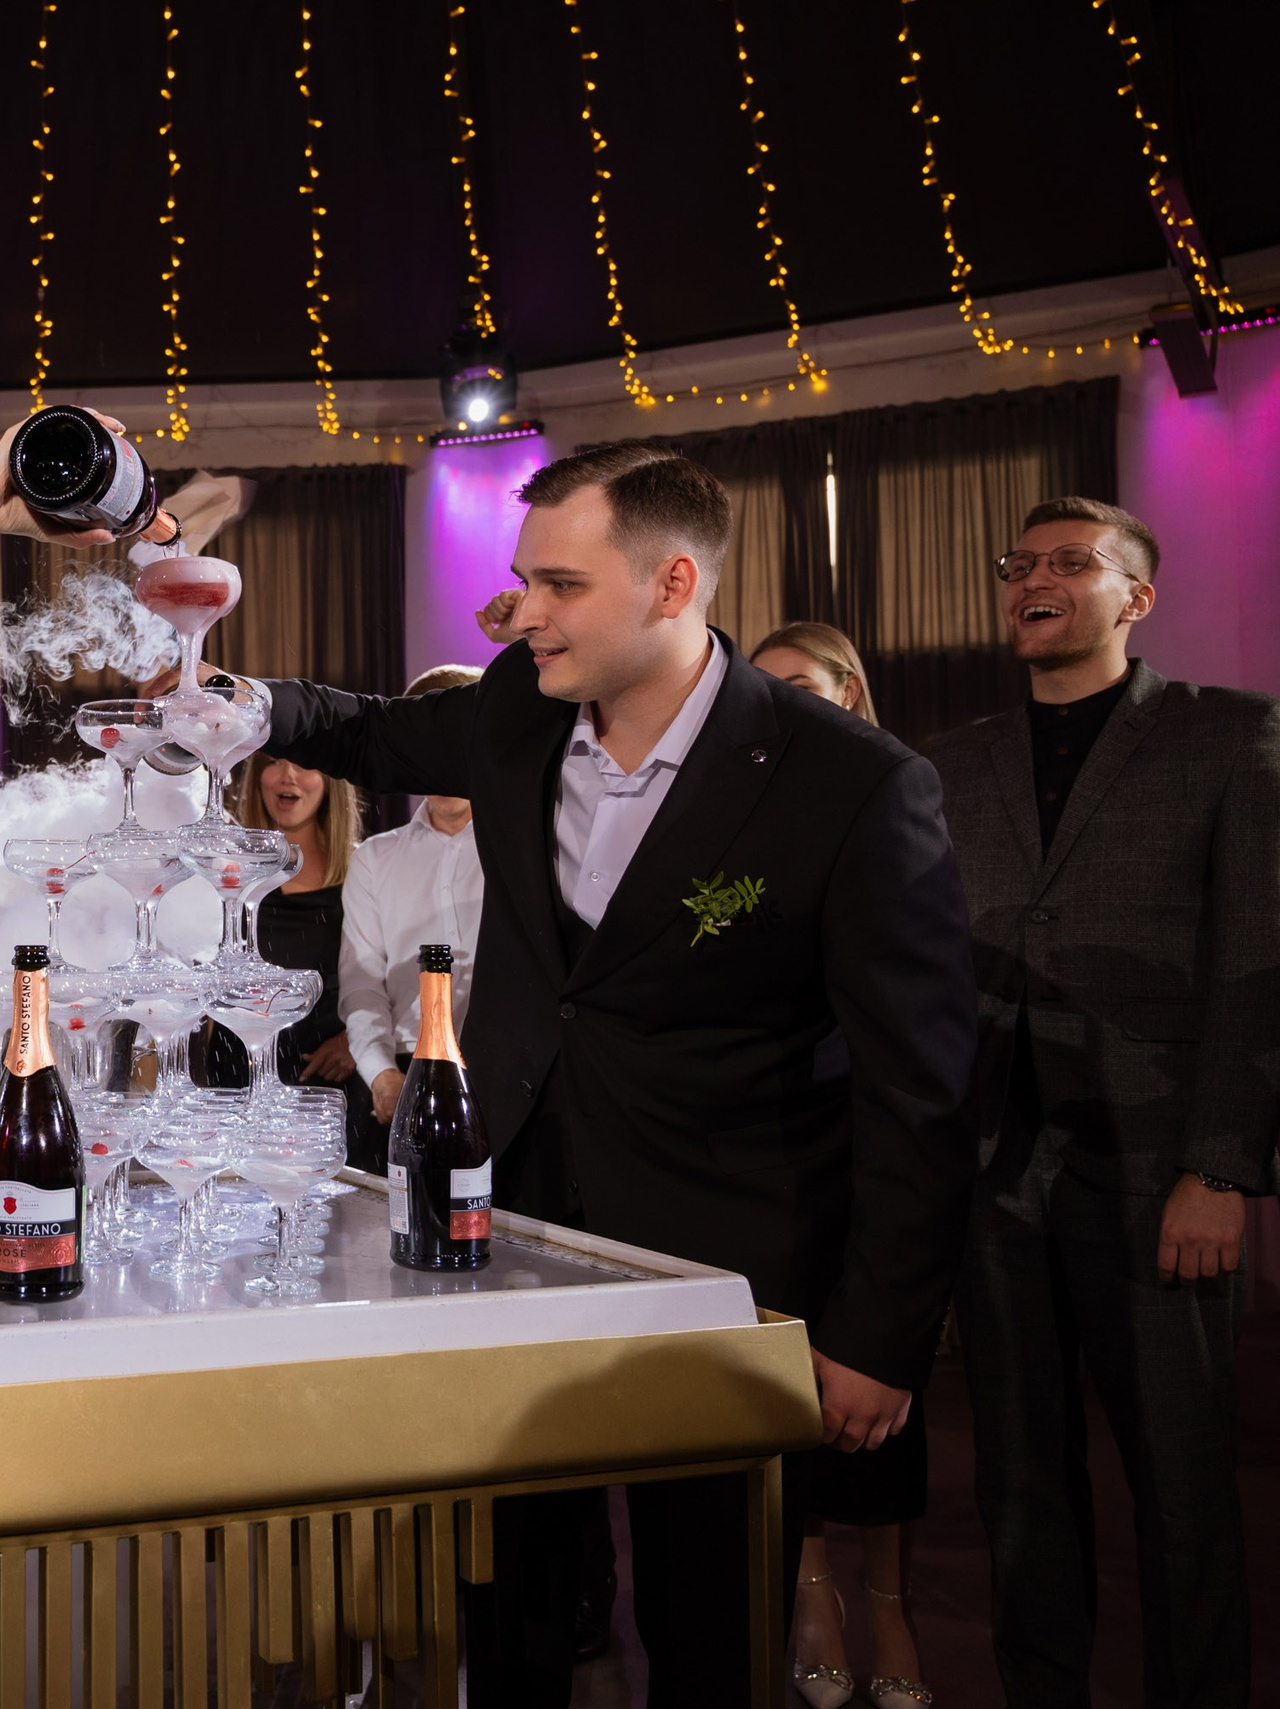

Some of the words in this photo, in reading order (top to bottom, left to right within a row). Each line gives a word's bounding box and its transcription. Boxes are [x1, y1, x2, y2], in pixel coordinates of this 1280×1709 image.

[21, 975, 31, 1019] STEFANO
[20, 1022, 30, 1054] SANTO
[467, 1196, 491, 1210] SANTO
[5, 1223, 61, 1236] STEFANO
